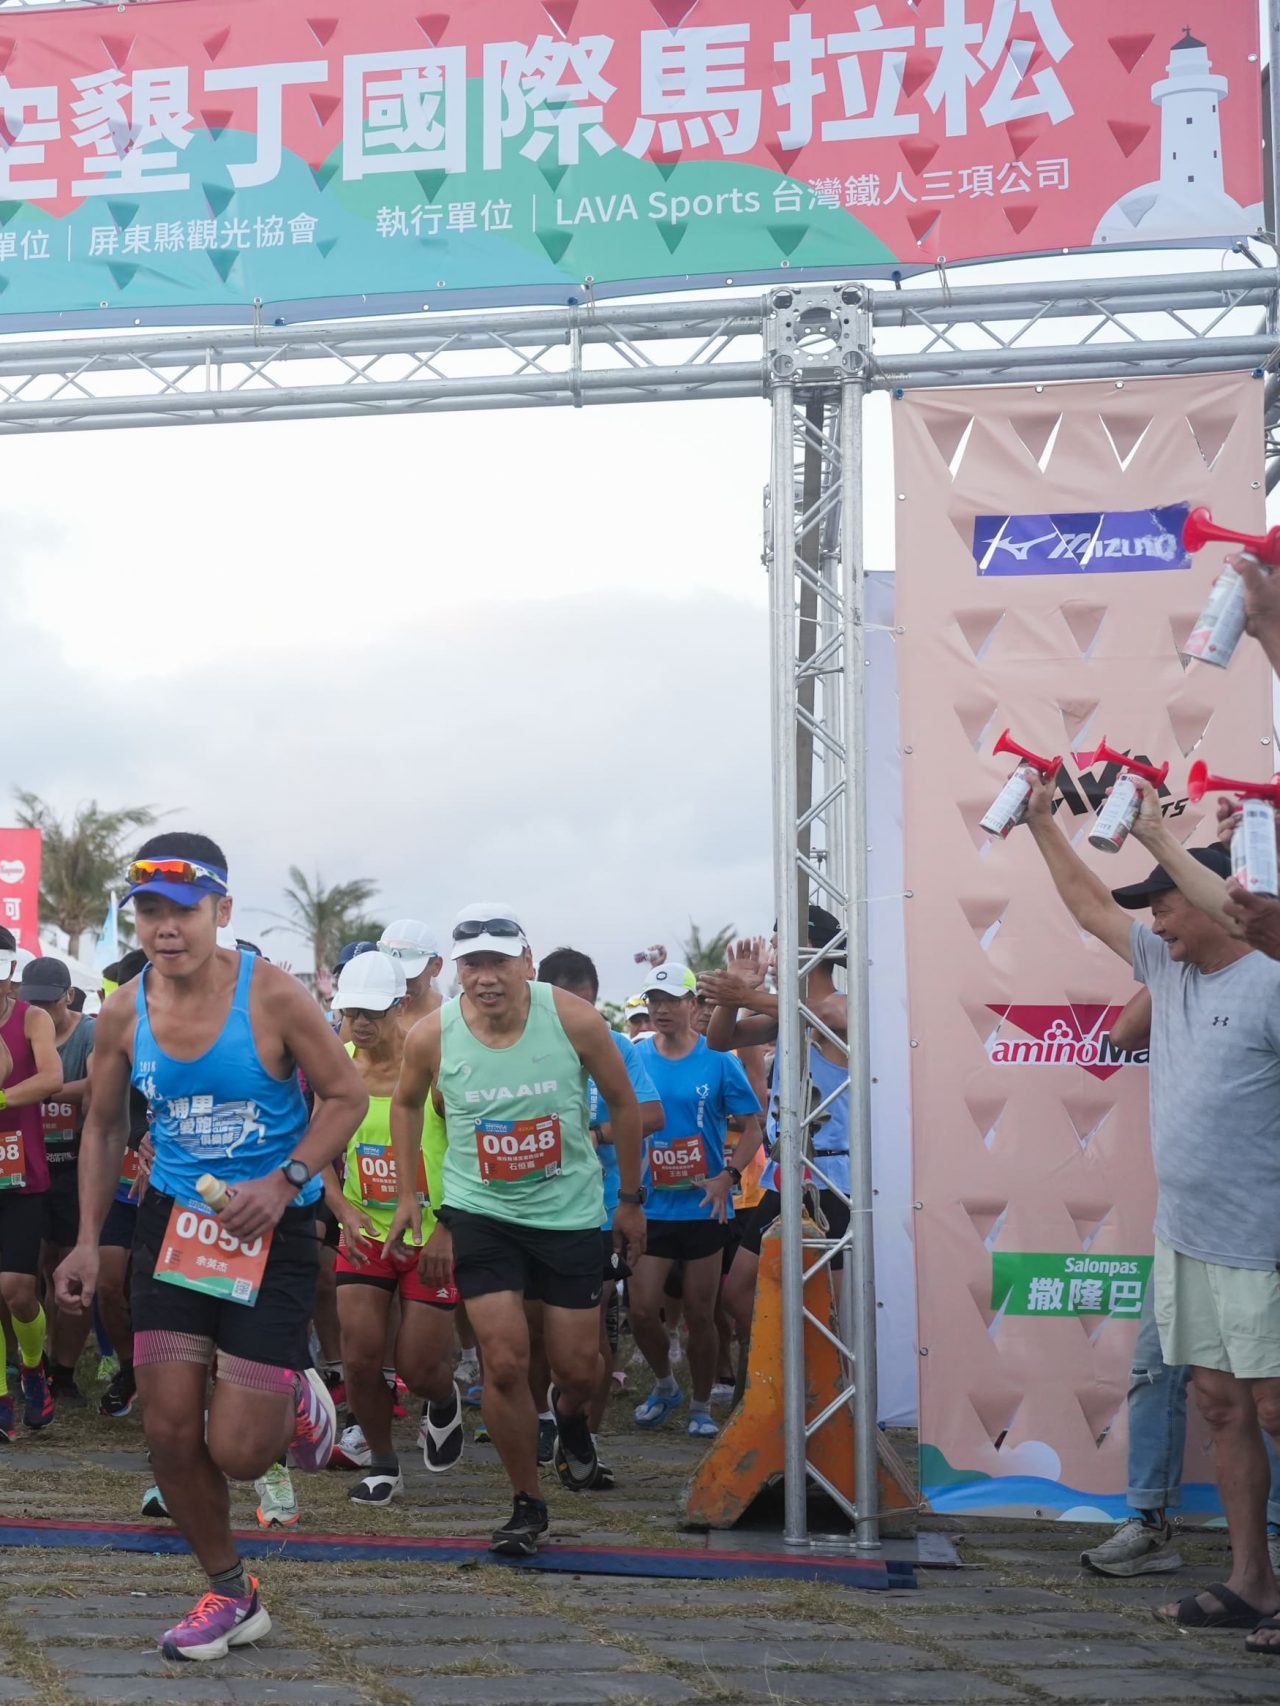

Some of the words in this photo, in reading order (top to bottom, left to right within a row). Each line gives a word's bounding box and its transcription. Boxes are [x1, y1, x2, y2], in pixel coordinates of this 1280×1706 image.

[556, 193, 639, 226] LAVA
[647, 187, 761, 226] Sports
[771, 157, 1070, 214] 台灣鐵人三項公司
[375, 198, 513, 238] 執行單位
[88, 211, 320, 257] 屏東縣觀光協會
[465, 1087, 514, 1103] EVA
[516, 1080, 558, 1097] AIR
[482, 1130, 556, 1155] 0048
[652, 1147, 702, 1166] 0054
[1064, 1257, 1138, 1277] Salonpas
